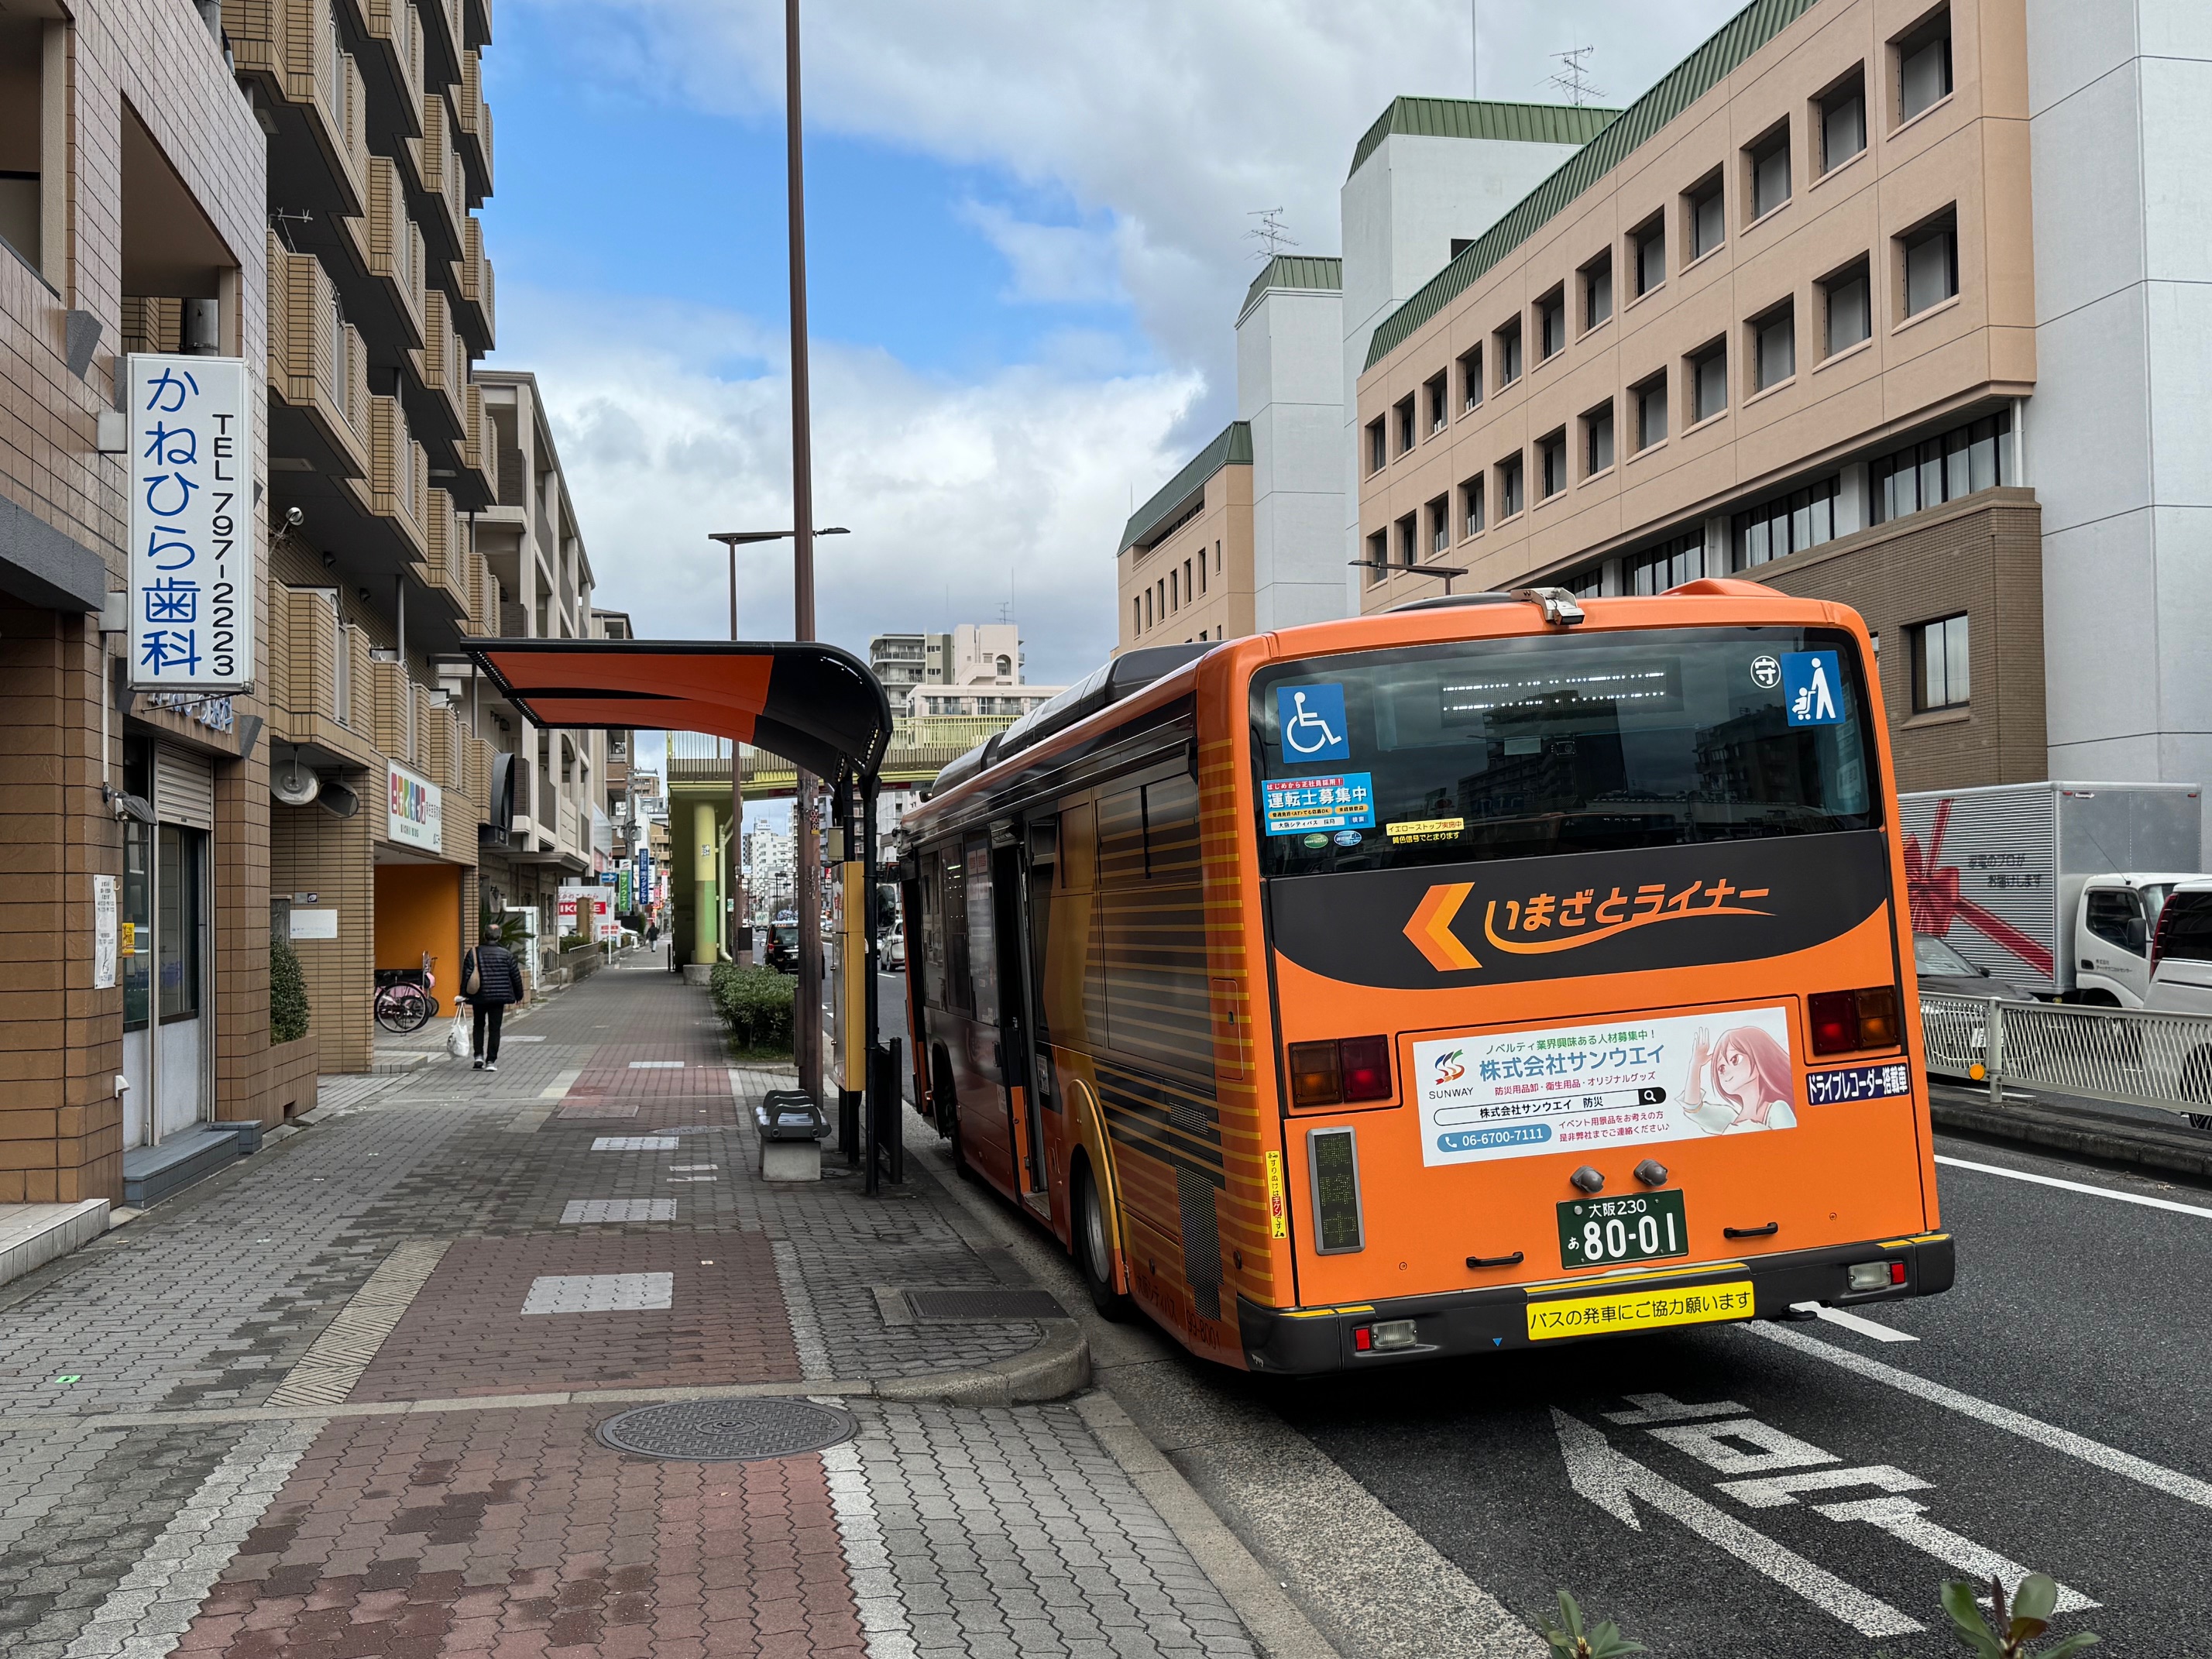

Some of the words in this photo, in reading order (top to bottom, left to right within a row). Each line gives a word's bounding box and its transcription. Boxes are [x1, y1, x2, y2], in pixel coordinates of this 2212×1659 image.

[212, 414, 234, 481] TEL
[141, 367, 201, 676] かねひら歯科
[212, 492, 234, 676] 797-2223
[1753, 658, 1779, 686] 守
[1267, 778, 1341, 790] はじめから正社員採用！
[1267, 785, 1367, 809] 運転士募集中
[1388, 821, 1462, 833] イエローストップ実施中
[1392, 832, 1460, 844] 黄色信号でとまります
[1484, 878, 1771, 942] いまざとライナー
[1486, 1029, 1655, 1055] ノベルティ業界興味ある人材募集中！
[1479, 1044, 1664, 1082] 株式会社サンウエイ
[1429, 1087, 1474, 1100] SUNWAY
[1808, 1065, 1908, 1104] ドライブレコーダー搭載車
[1479, 1099, 1572, 1119] 株式会社サンウエイ
[1582, 1096, 1603, 1108] 防災
[1558, 1111, 1664, 1130] イベント用景品をお考えの方
[1462, 1128, 1544, 1146] 06-6700-7111
[1567, 1236, 1580, 1251] あ
[1582, 1212, 1677, 1261] 80-01
[1530, 1291, 1751, 1331] バスの発車にご協力願います
